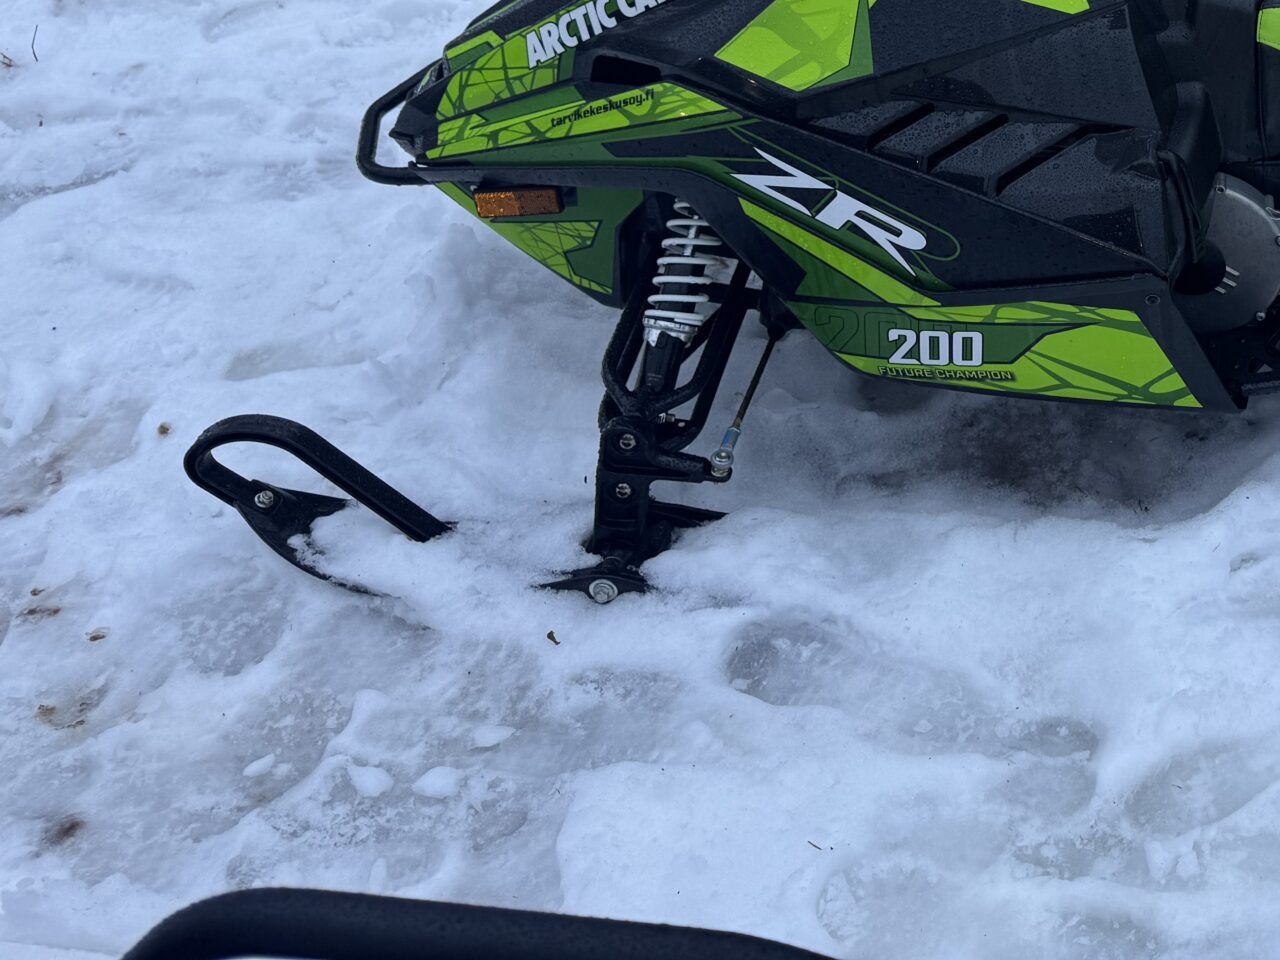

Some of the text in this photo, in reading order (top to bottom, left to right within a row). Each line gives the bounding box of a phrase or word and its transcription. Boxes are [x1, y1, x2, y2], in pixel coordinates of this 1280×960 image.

[551, 89, 655, 128] tarvikekeskusoy.fi
[729, 146, 927, 277] ZR
[888, 328, 983, 367] 200
[878, 366, 1012, 380] FUTURE CHAMPION
